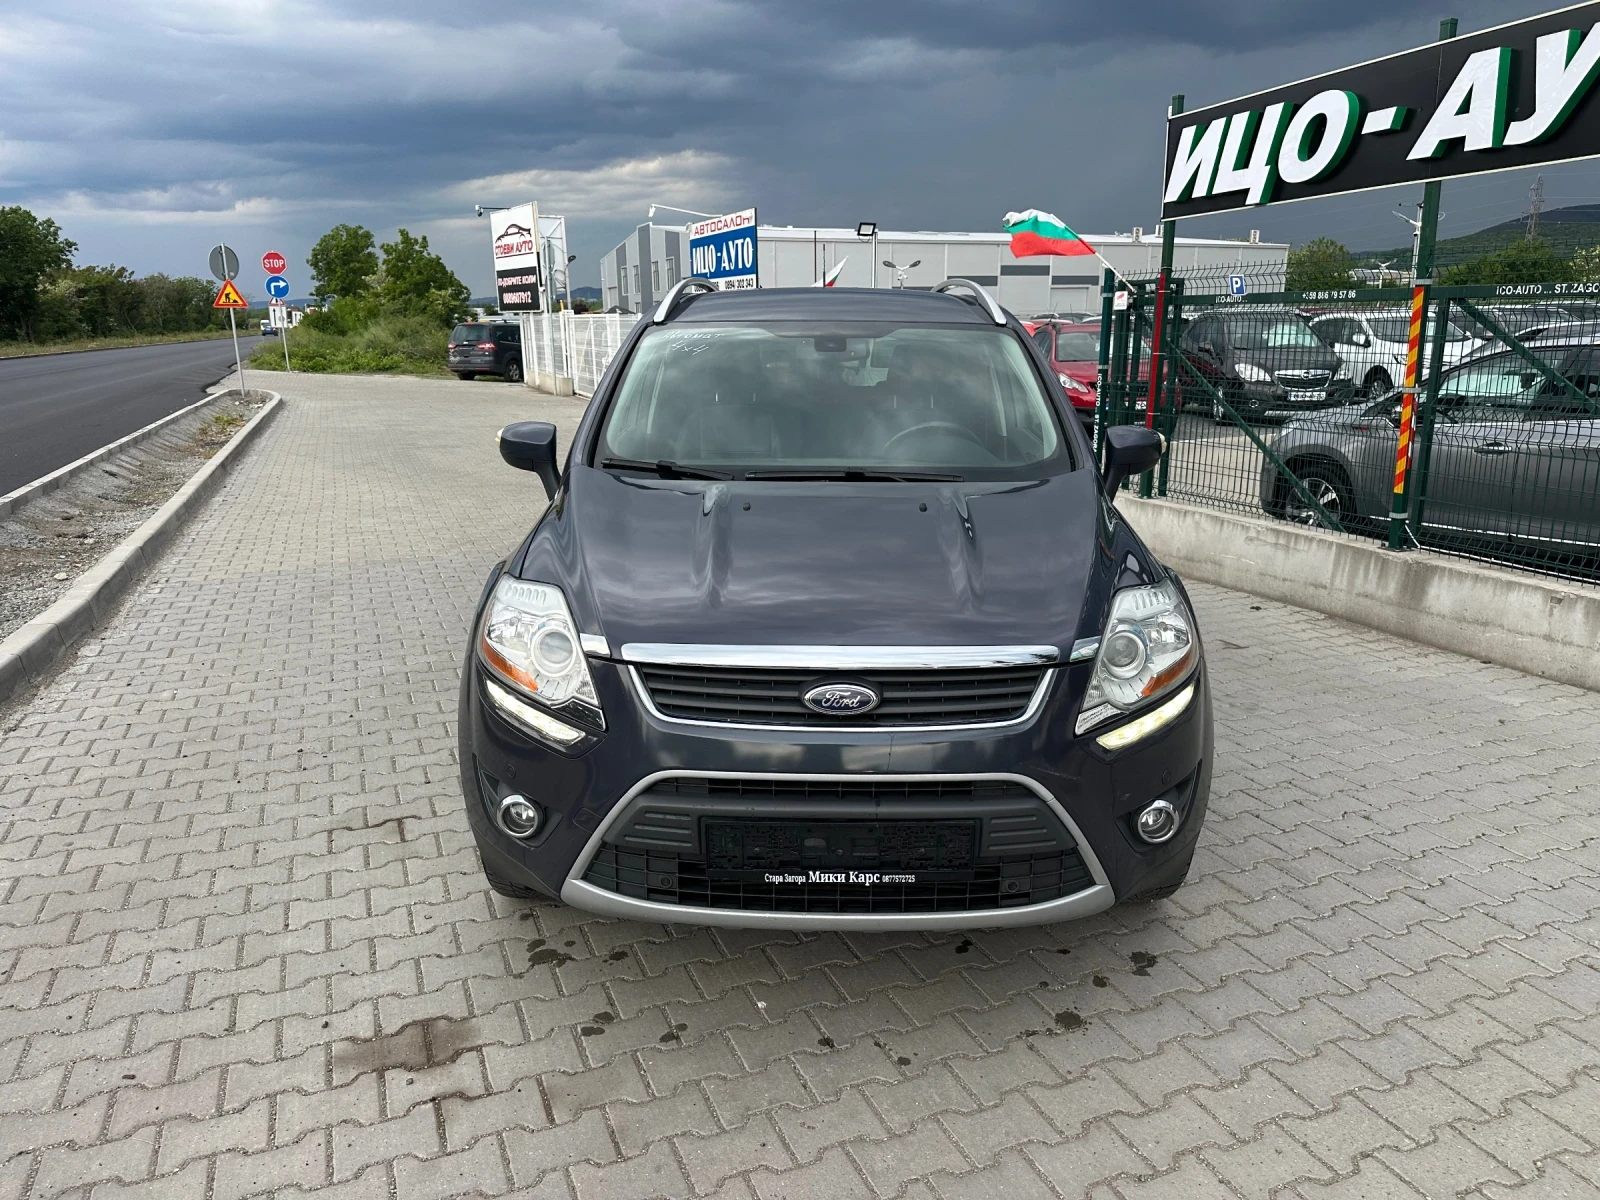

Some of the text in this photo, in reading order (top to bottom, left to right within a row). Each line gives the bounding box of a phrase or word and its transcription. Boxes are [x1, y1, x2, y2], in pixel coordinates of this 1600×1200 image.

[495, 239, 533, 256] СТОЕВИ АУТО
[264, 259, 284, 268] STOP
[692, 236, 753, 278] ИЦО-АУТО
[1232, 277, 1242, 293] P
[1554, 283, 1568, 294] ST.
[1338, 290, 1347, 299] 57
[1347, 289, 1356, 299] 86
[821, 690, 861, 708] Ford
[764, 873, 784, 885] Стара
[784, 873, 807, 885] Загора
[808, 871, 846, 883] Мики
[848, 871, 880, 886] Карс
